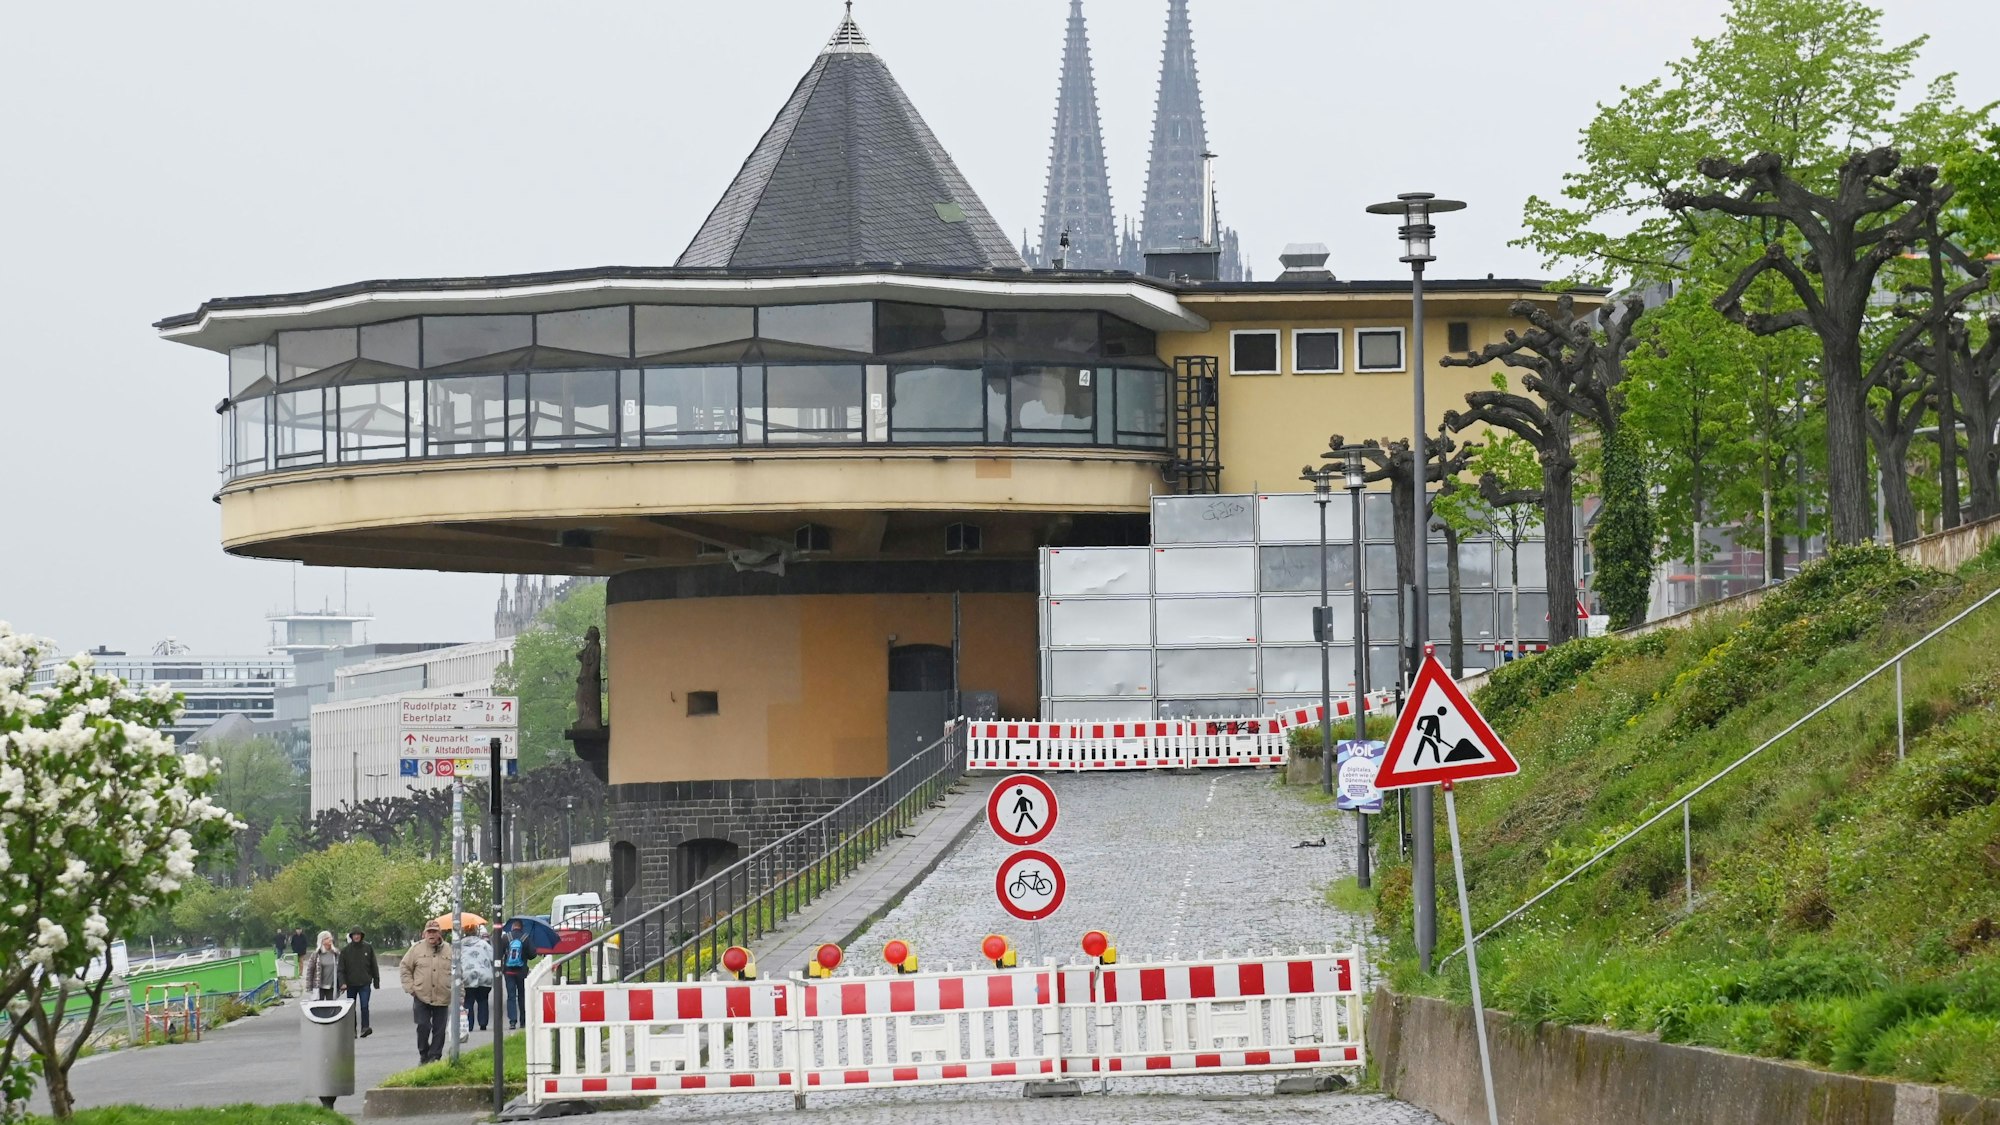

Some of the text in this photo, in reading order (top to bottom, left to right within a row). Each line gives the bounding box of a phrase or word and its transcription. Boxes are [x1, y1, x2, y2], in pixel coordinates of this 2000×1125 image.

[1080, 371, 1089, 385] 4
[872, 395, 881, 408] 5
[626, 401, 634, 415] 6
[403, 702, 457, 712] Rudolfplatz
[403, 714, 452, 723] Ebertplatz
[421, 734, 469, 743] Neumarkt
[1345, 743, 1375, 757] Volt
[439, 763, 450, 772] 99
